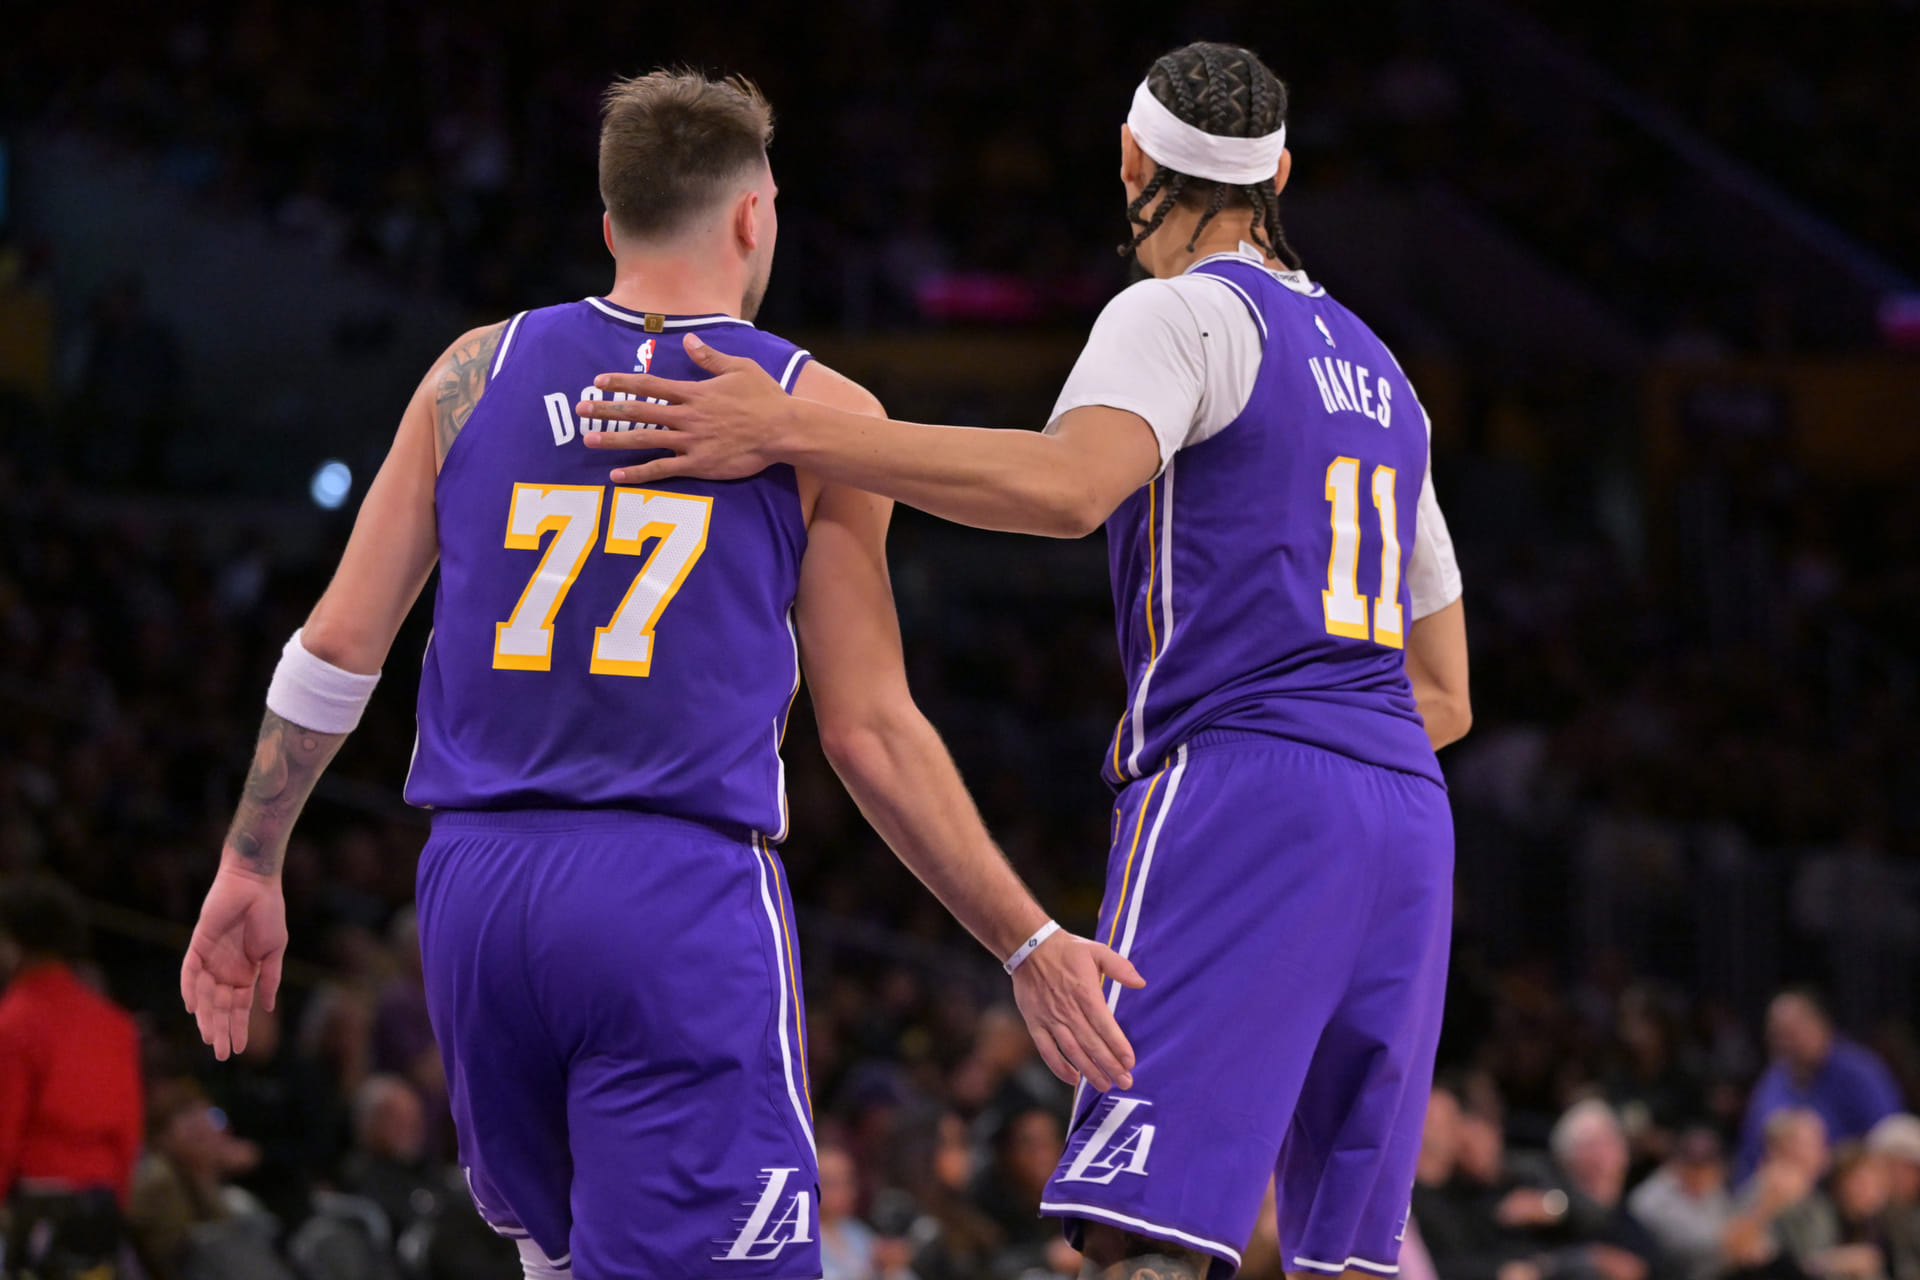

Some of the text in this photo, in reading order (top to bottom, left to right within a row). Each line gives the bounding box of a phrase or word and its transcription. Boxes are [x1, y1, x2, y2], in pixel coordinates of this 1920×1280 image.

[1308, 356, 1392, 428] HAYES
[492, 482, 714, 678] 77
[1321, 455, 1404, 650] 11
[1055, 1095, 1156, 1185] LA
[711, 1167, 814, 1261] LA
